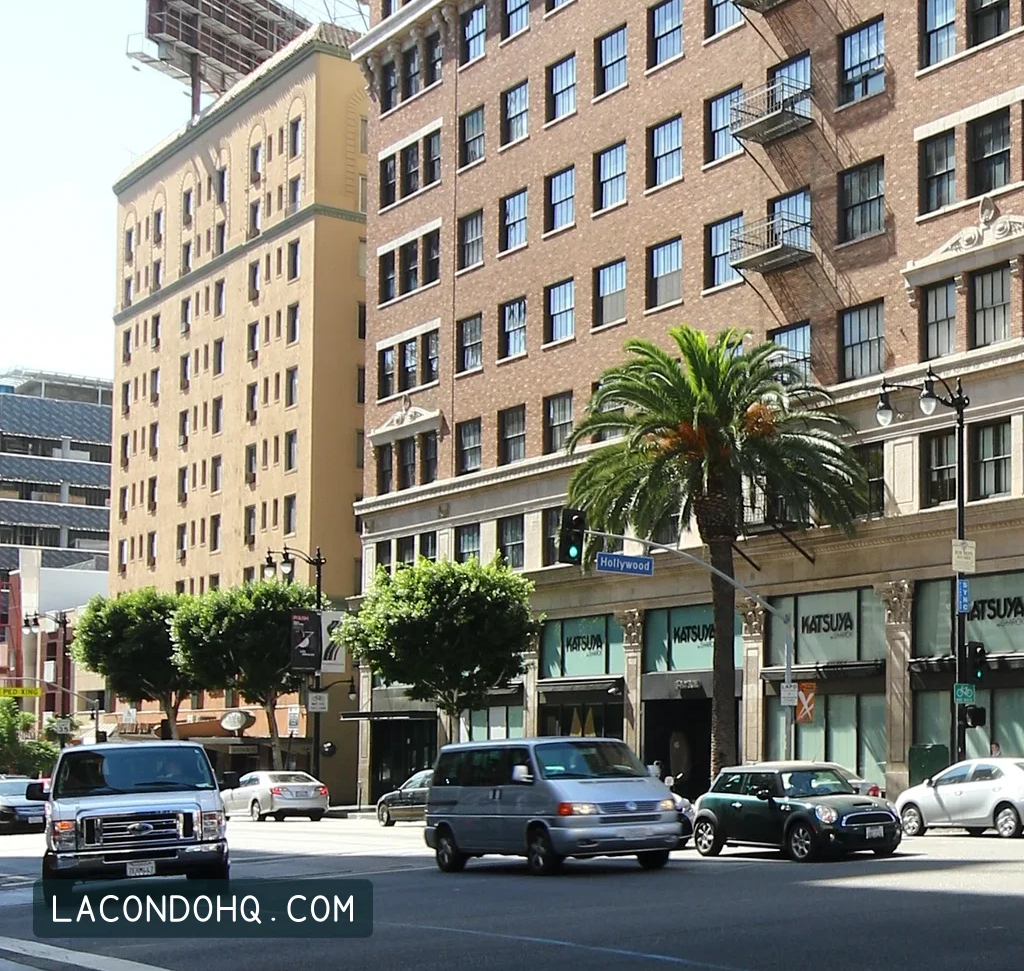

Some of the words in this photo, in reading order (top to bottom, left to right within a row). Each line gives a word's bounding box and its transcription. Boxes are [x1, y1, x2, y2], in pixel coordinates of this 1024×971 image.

[600, 556, 650, 570] Hollywood
[801, 612, 854, 634] KATSUYA
[566, 634, 603, 652] KATSUYA
